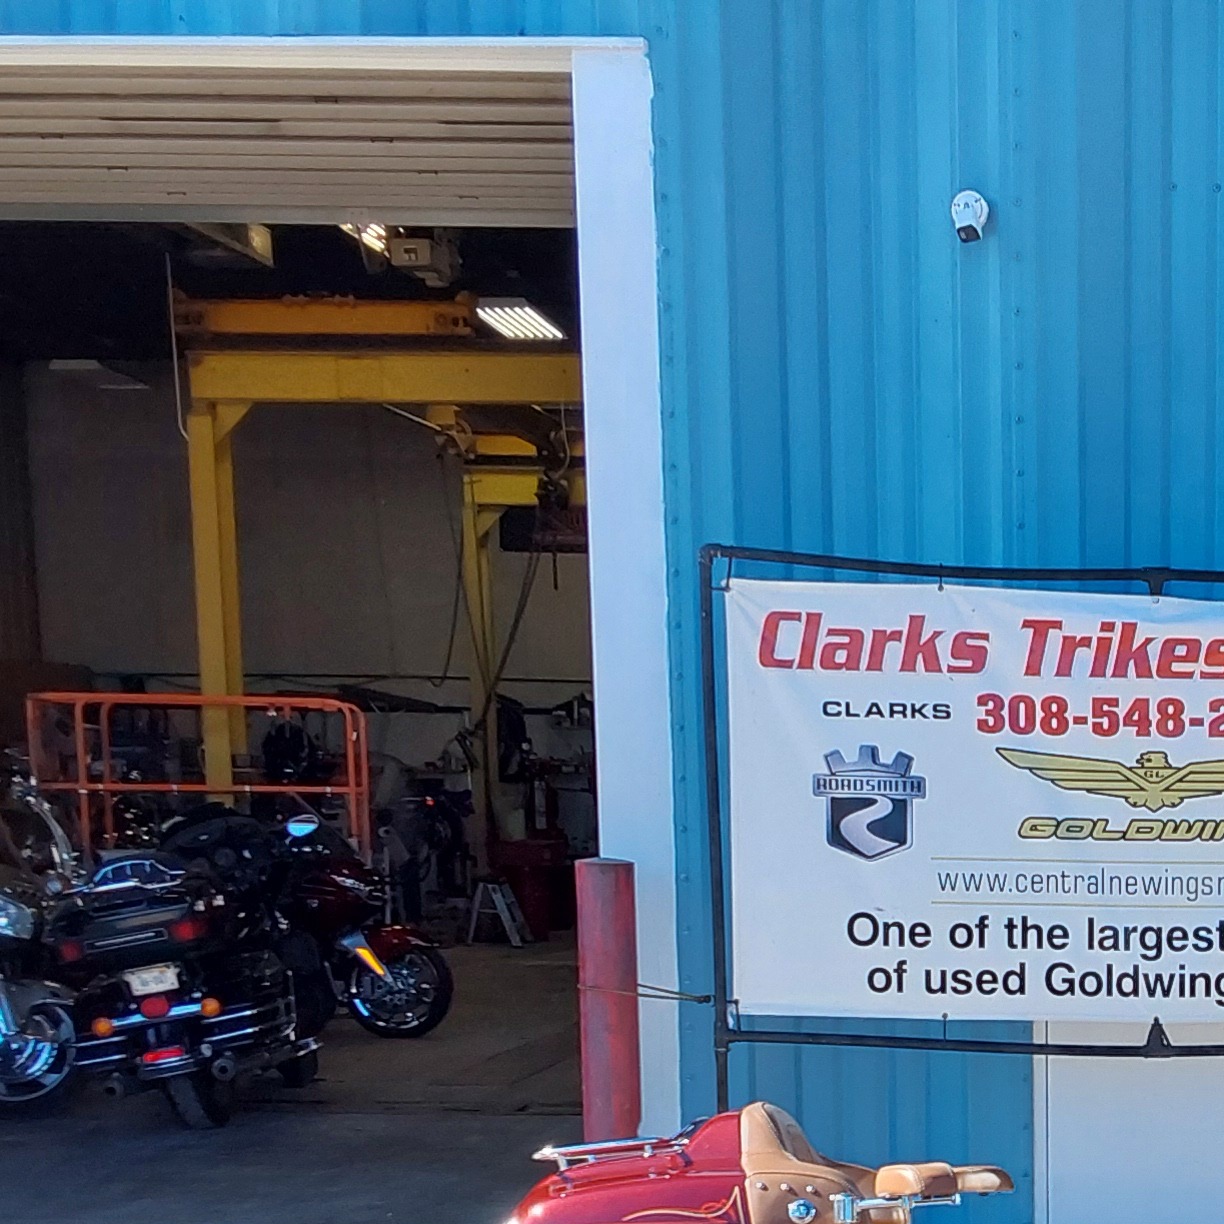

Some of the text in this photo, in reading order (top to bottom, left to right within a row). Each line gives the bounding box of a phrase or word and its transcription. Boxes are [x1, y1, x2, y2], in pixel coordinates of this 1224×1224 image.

[758, 610, 990, 674] Clarks
[822, 700, 952, 720] CLARKS
[816, 777, 922, 793] ROADSMITH
[1143, 770, 1165, 779] GL
[846, 911, 932, 948] One
[949, 914, 990, 949] of
[1003, 915, 1070, 950] the
[866, 959, 908, 993] of
[924, 962, 1026, 996] used
